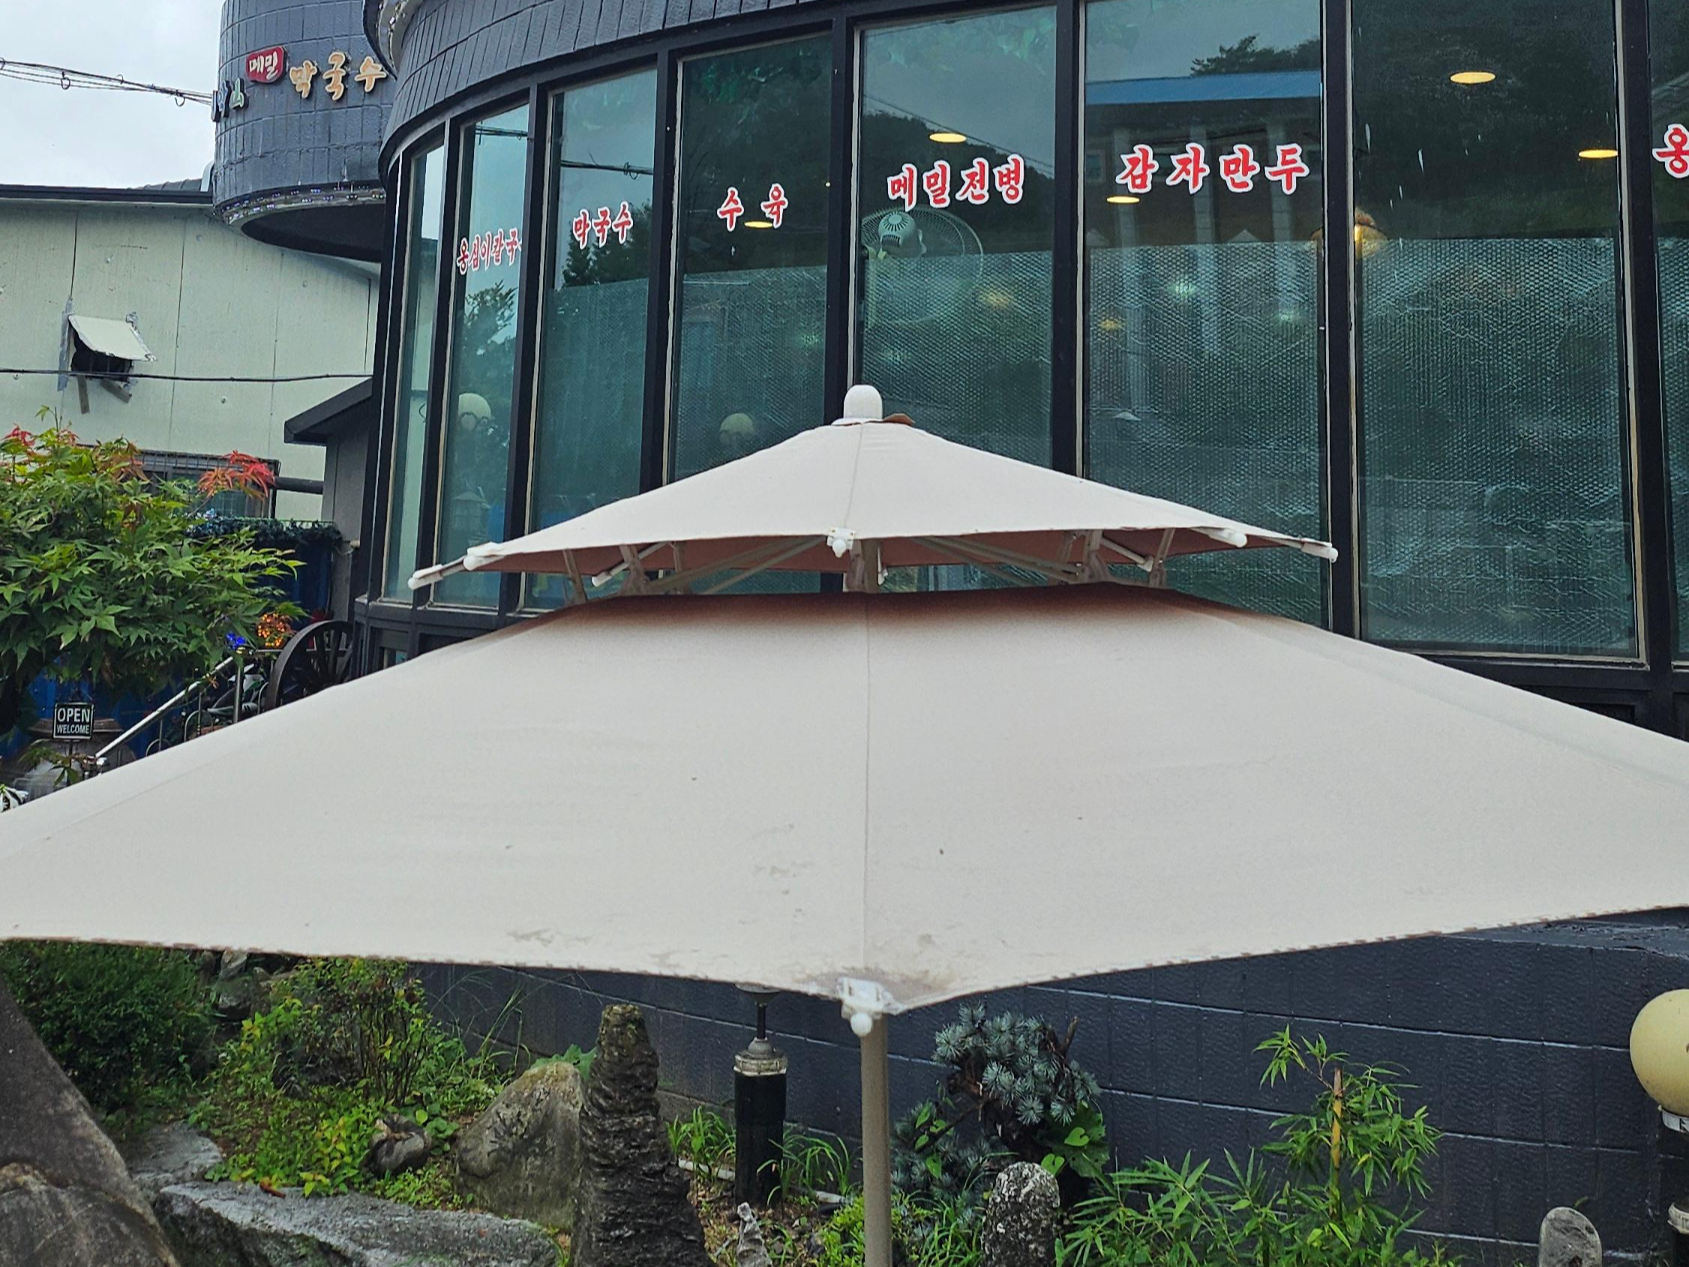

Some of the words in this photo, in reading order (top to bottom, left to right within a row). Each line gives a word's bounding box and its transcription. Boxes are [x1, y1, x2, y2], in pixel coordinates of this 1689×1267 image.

[248, 50, 279, 81] 메밀
[290, 51, 387, 102] 막국수
[887, 153, 1025, 211] 메밀전병
[1116, 142, 1309, 195] 감자만두
[572, 200, 633, 249] 막국수
[457, 228, 522, 275] 옹심이칼국
[57, 708, 90, 723] OPEN
[57, 724, 90, 734] WELCOME
